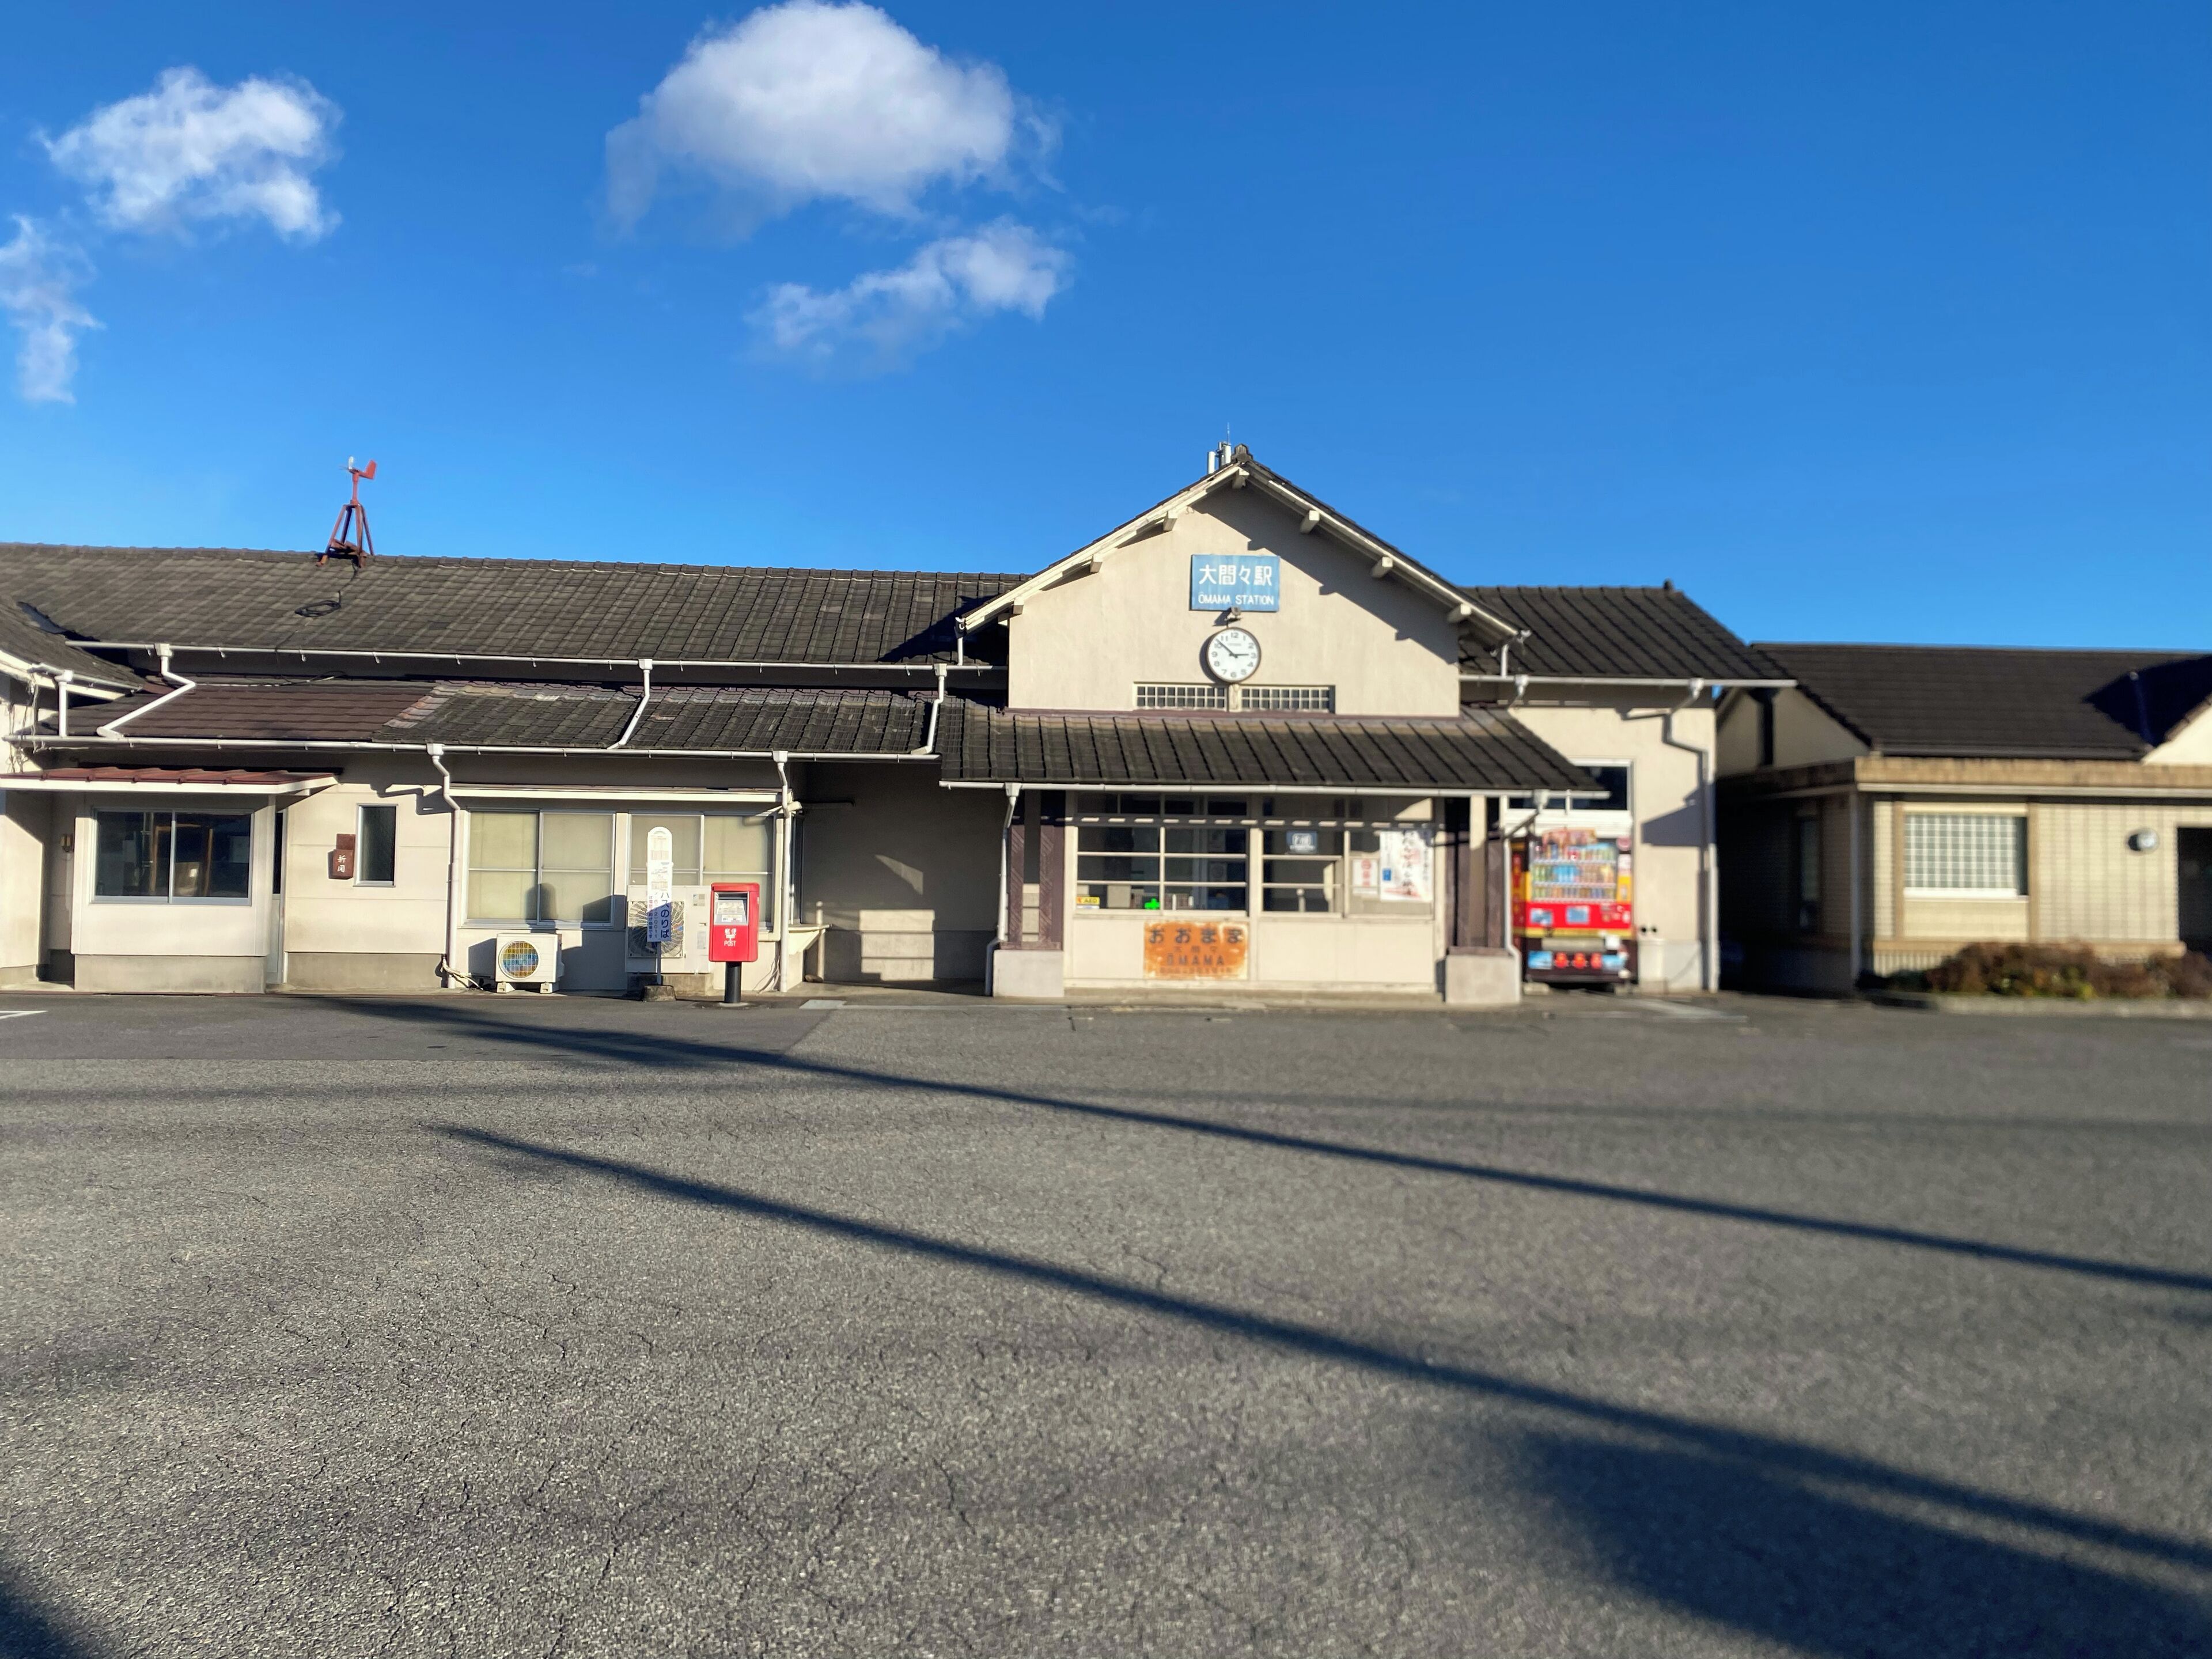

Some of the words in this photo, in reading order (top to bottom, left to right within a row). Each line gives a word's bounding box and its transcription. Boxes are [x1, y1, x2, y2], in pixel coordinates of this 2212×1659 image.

[1198, 564, 1272, 586] 大間々駅
[1235, 594, 1274, 605] STATION
